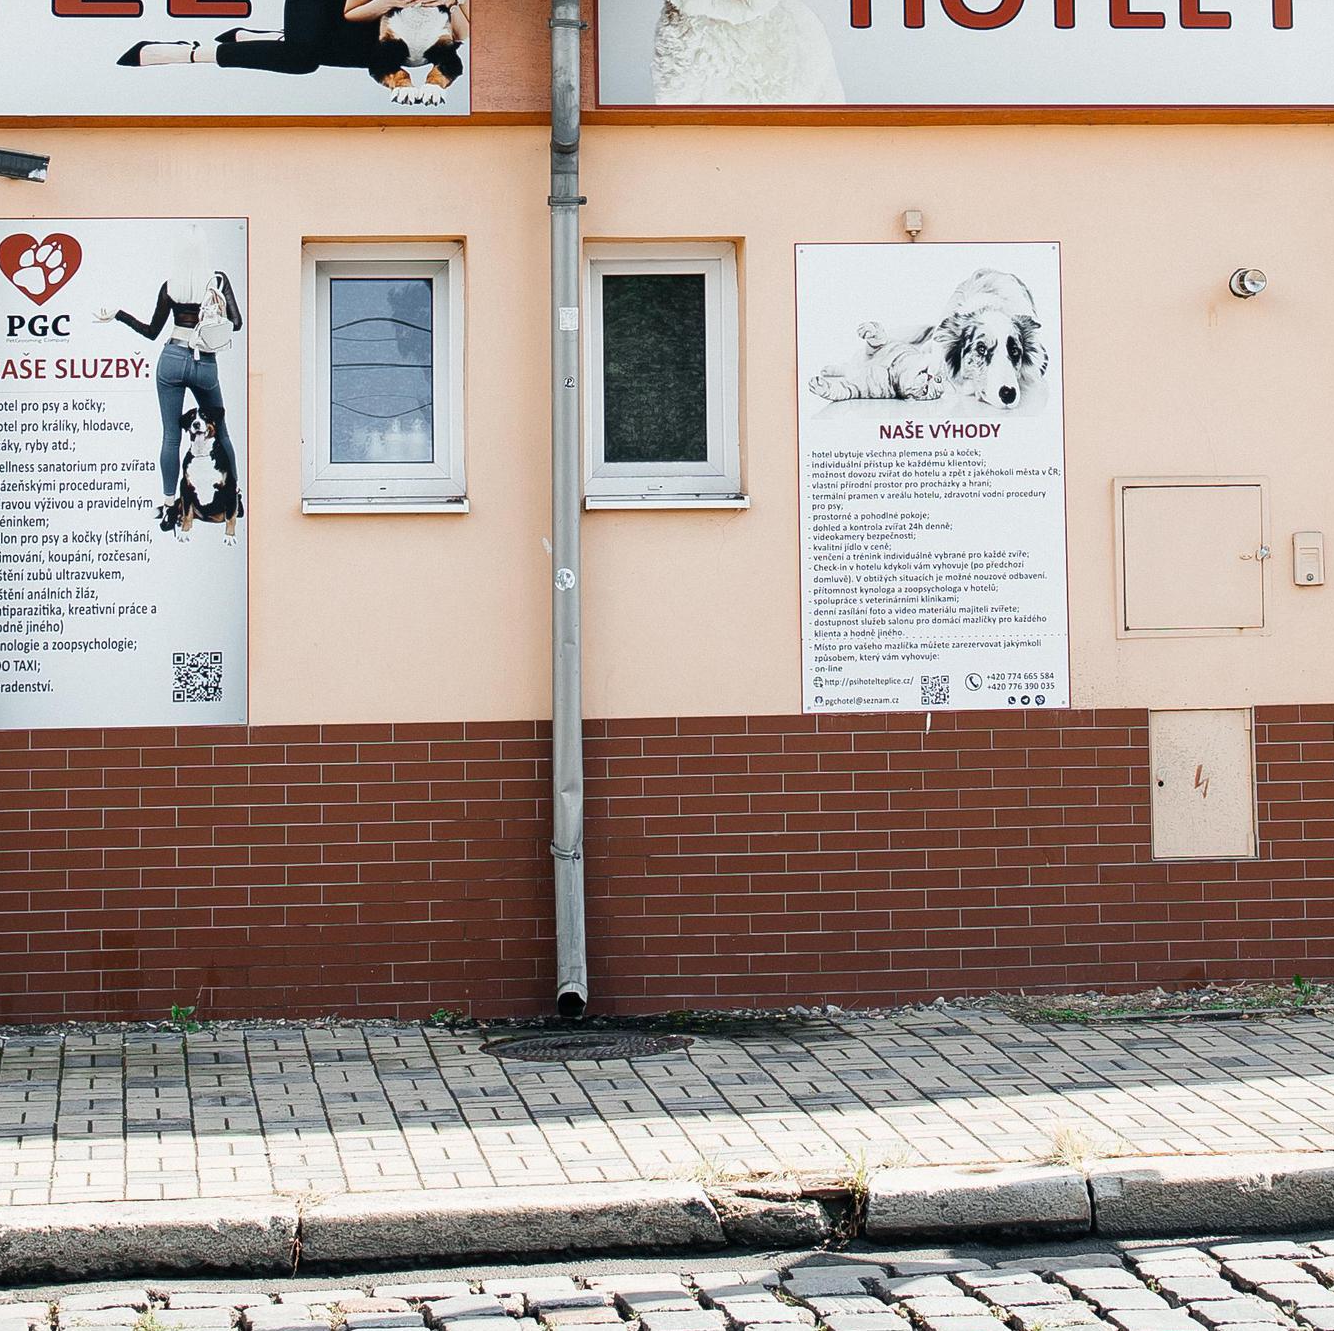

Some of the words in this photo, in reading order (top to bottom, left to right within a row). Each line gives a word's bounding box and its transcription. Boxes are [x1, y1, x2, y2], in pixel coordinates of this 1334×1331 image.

[6, 314, 70, 337] PGC
[20, 402, 39, 414] pro
[42, 402, 60, 414] psy
[62, 402, 68, 411] a
[72, 398, 105, 413] kočky;
[20, 422, 38, 434] pro
[41, 419, 79, 434] králíky,
[82, 418, 133, 432] hlodavce,
[879, 420, 924, 439] NAŠE
[928, 420, 1001, 438] VÝHODY
[25, 438, 48, 453] ryby
[37, 460, 97, 473] sanatorium
[100, 462, 117, 474] pro
[120, 459, 155, 471] zvířata
[58, 478, 130, 494] procedurami,
[77, 500, 83, 509] a
[86, 495, 152, 511] pravidelným
[20, 534, 38, 546] pro
[41, 534, 59, 546] psy
[62, 534, 68, 543] a
[71, 530, 102, 545] kočky
[48, 549, 94, 565] koupání,
[26, 567, 52, 581] zubů
[55, 567, 124, 581] ultrazvukem,
[26, 586, 72, 600] análních
[75, 586, 98, 601] žláz,
[68, 602, 115, 615] kreativní
[118, 602, 147, 617] práce
[150, 604, 156, 614] a
[25, 619, 63, 635] jiného)
[42, 641, 48, 650] a
[51, 637, 136, 653] zoopsychologie;
[12, 659, 40, 673] TAXI;
